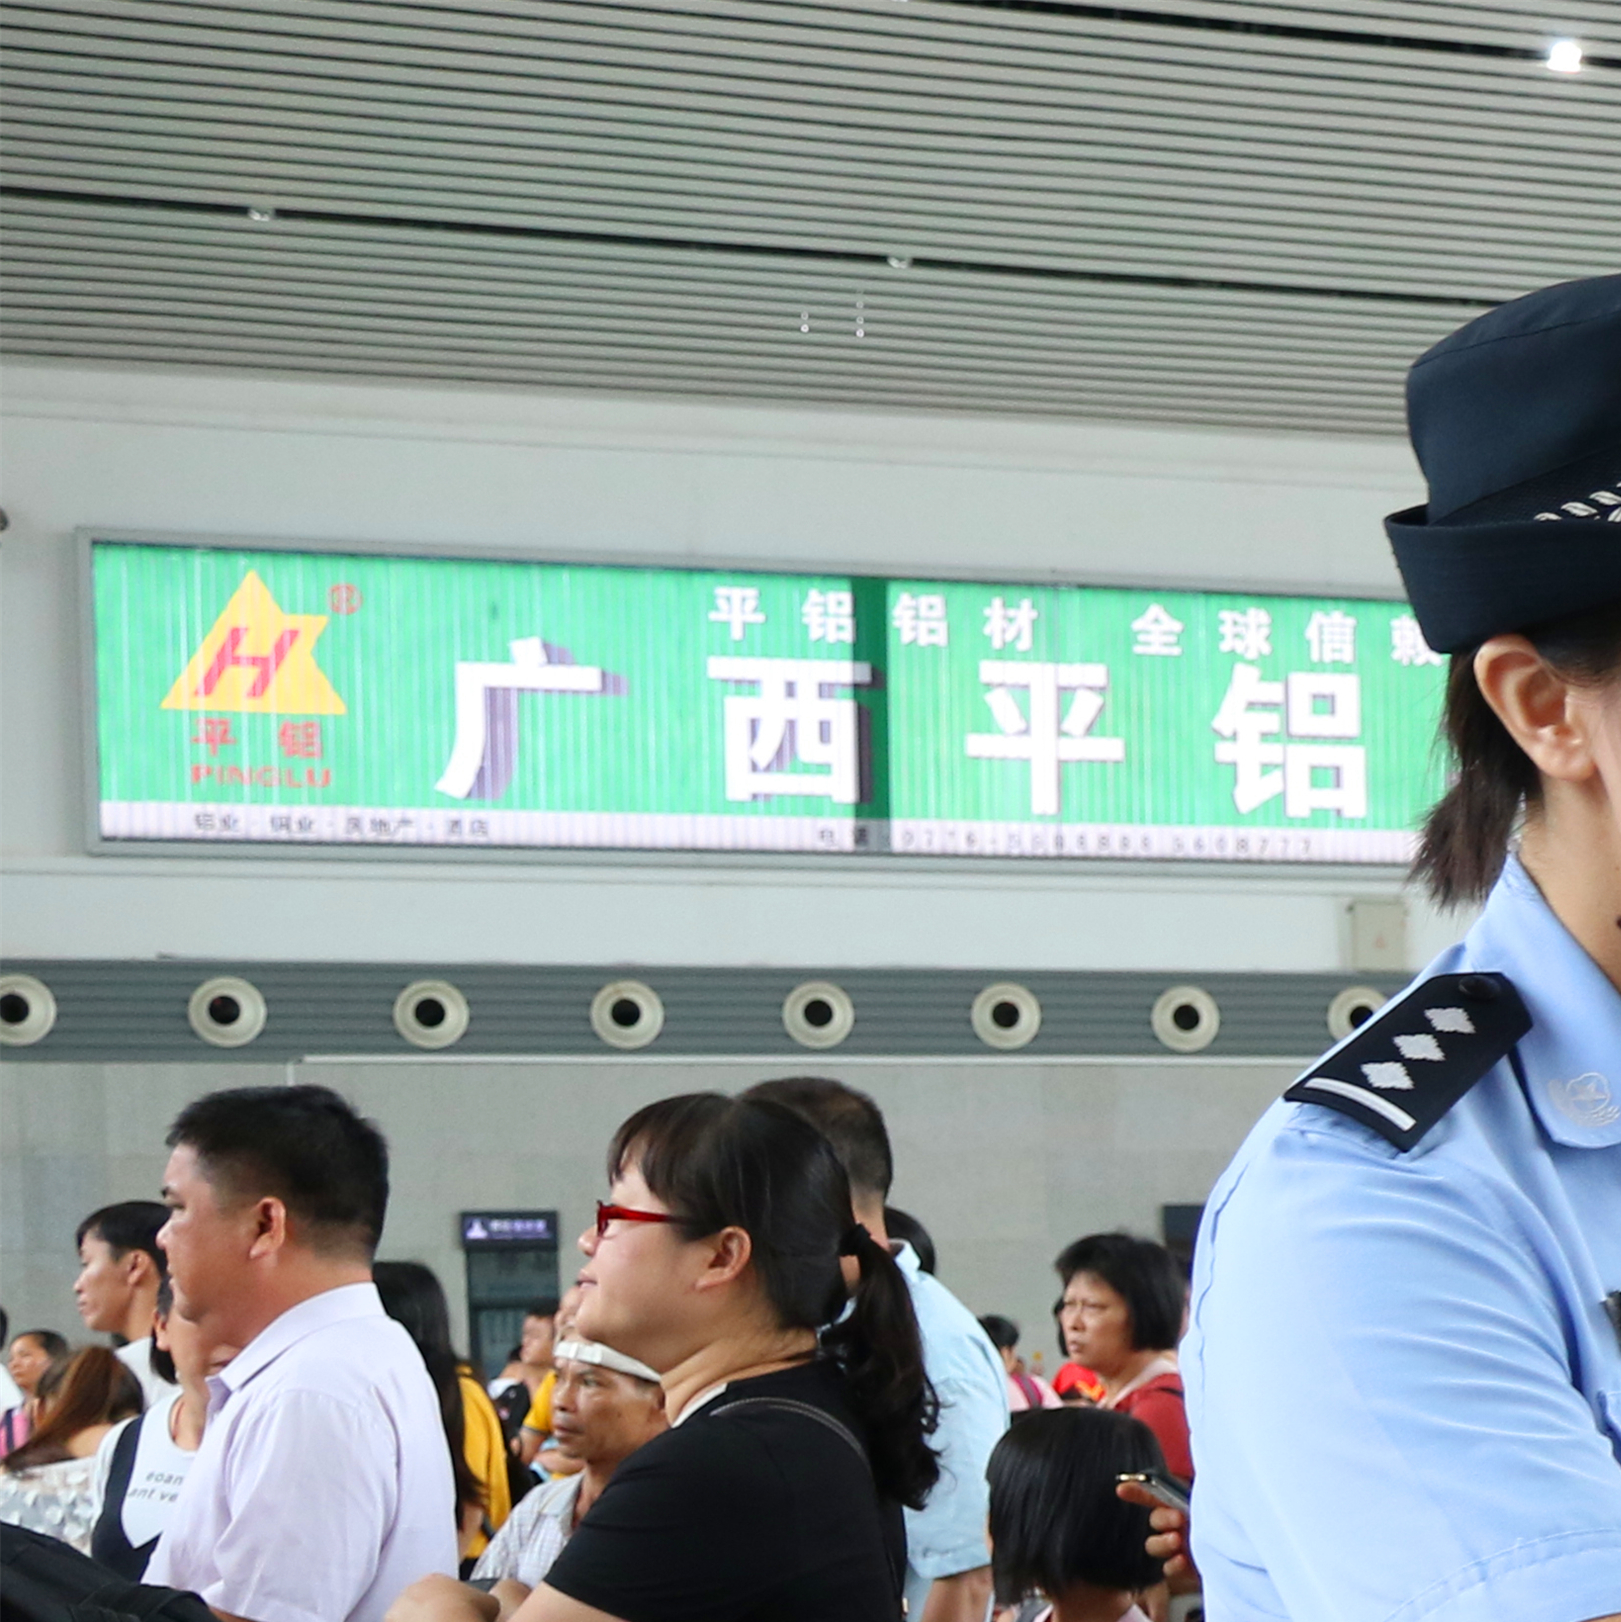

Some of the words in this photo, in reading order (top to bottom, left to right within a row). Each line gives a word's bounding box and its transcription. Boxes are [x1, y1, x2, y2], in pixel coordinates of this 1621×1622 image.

[708, 586, 1039, 652] 平铝铝材
[1130, 604, 1444, 667] 全球信赖
[190, 717, 324, 758] 平铝
[433, 636, 1368, 819] 广西平铝
[190, 765, 332, 788] PINGLU
